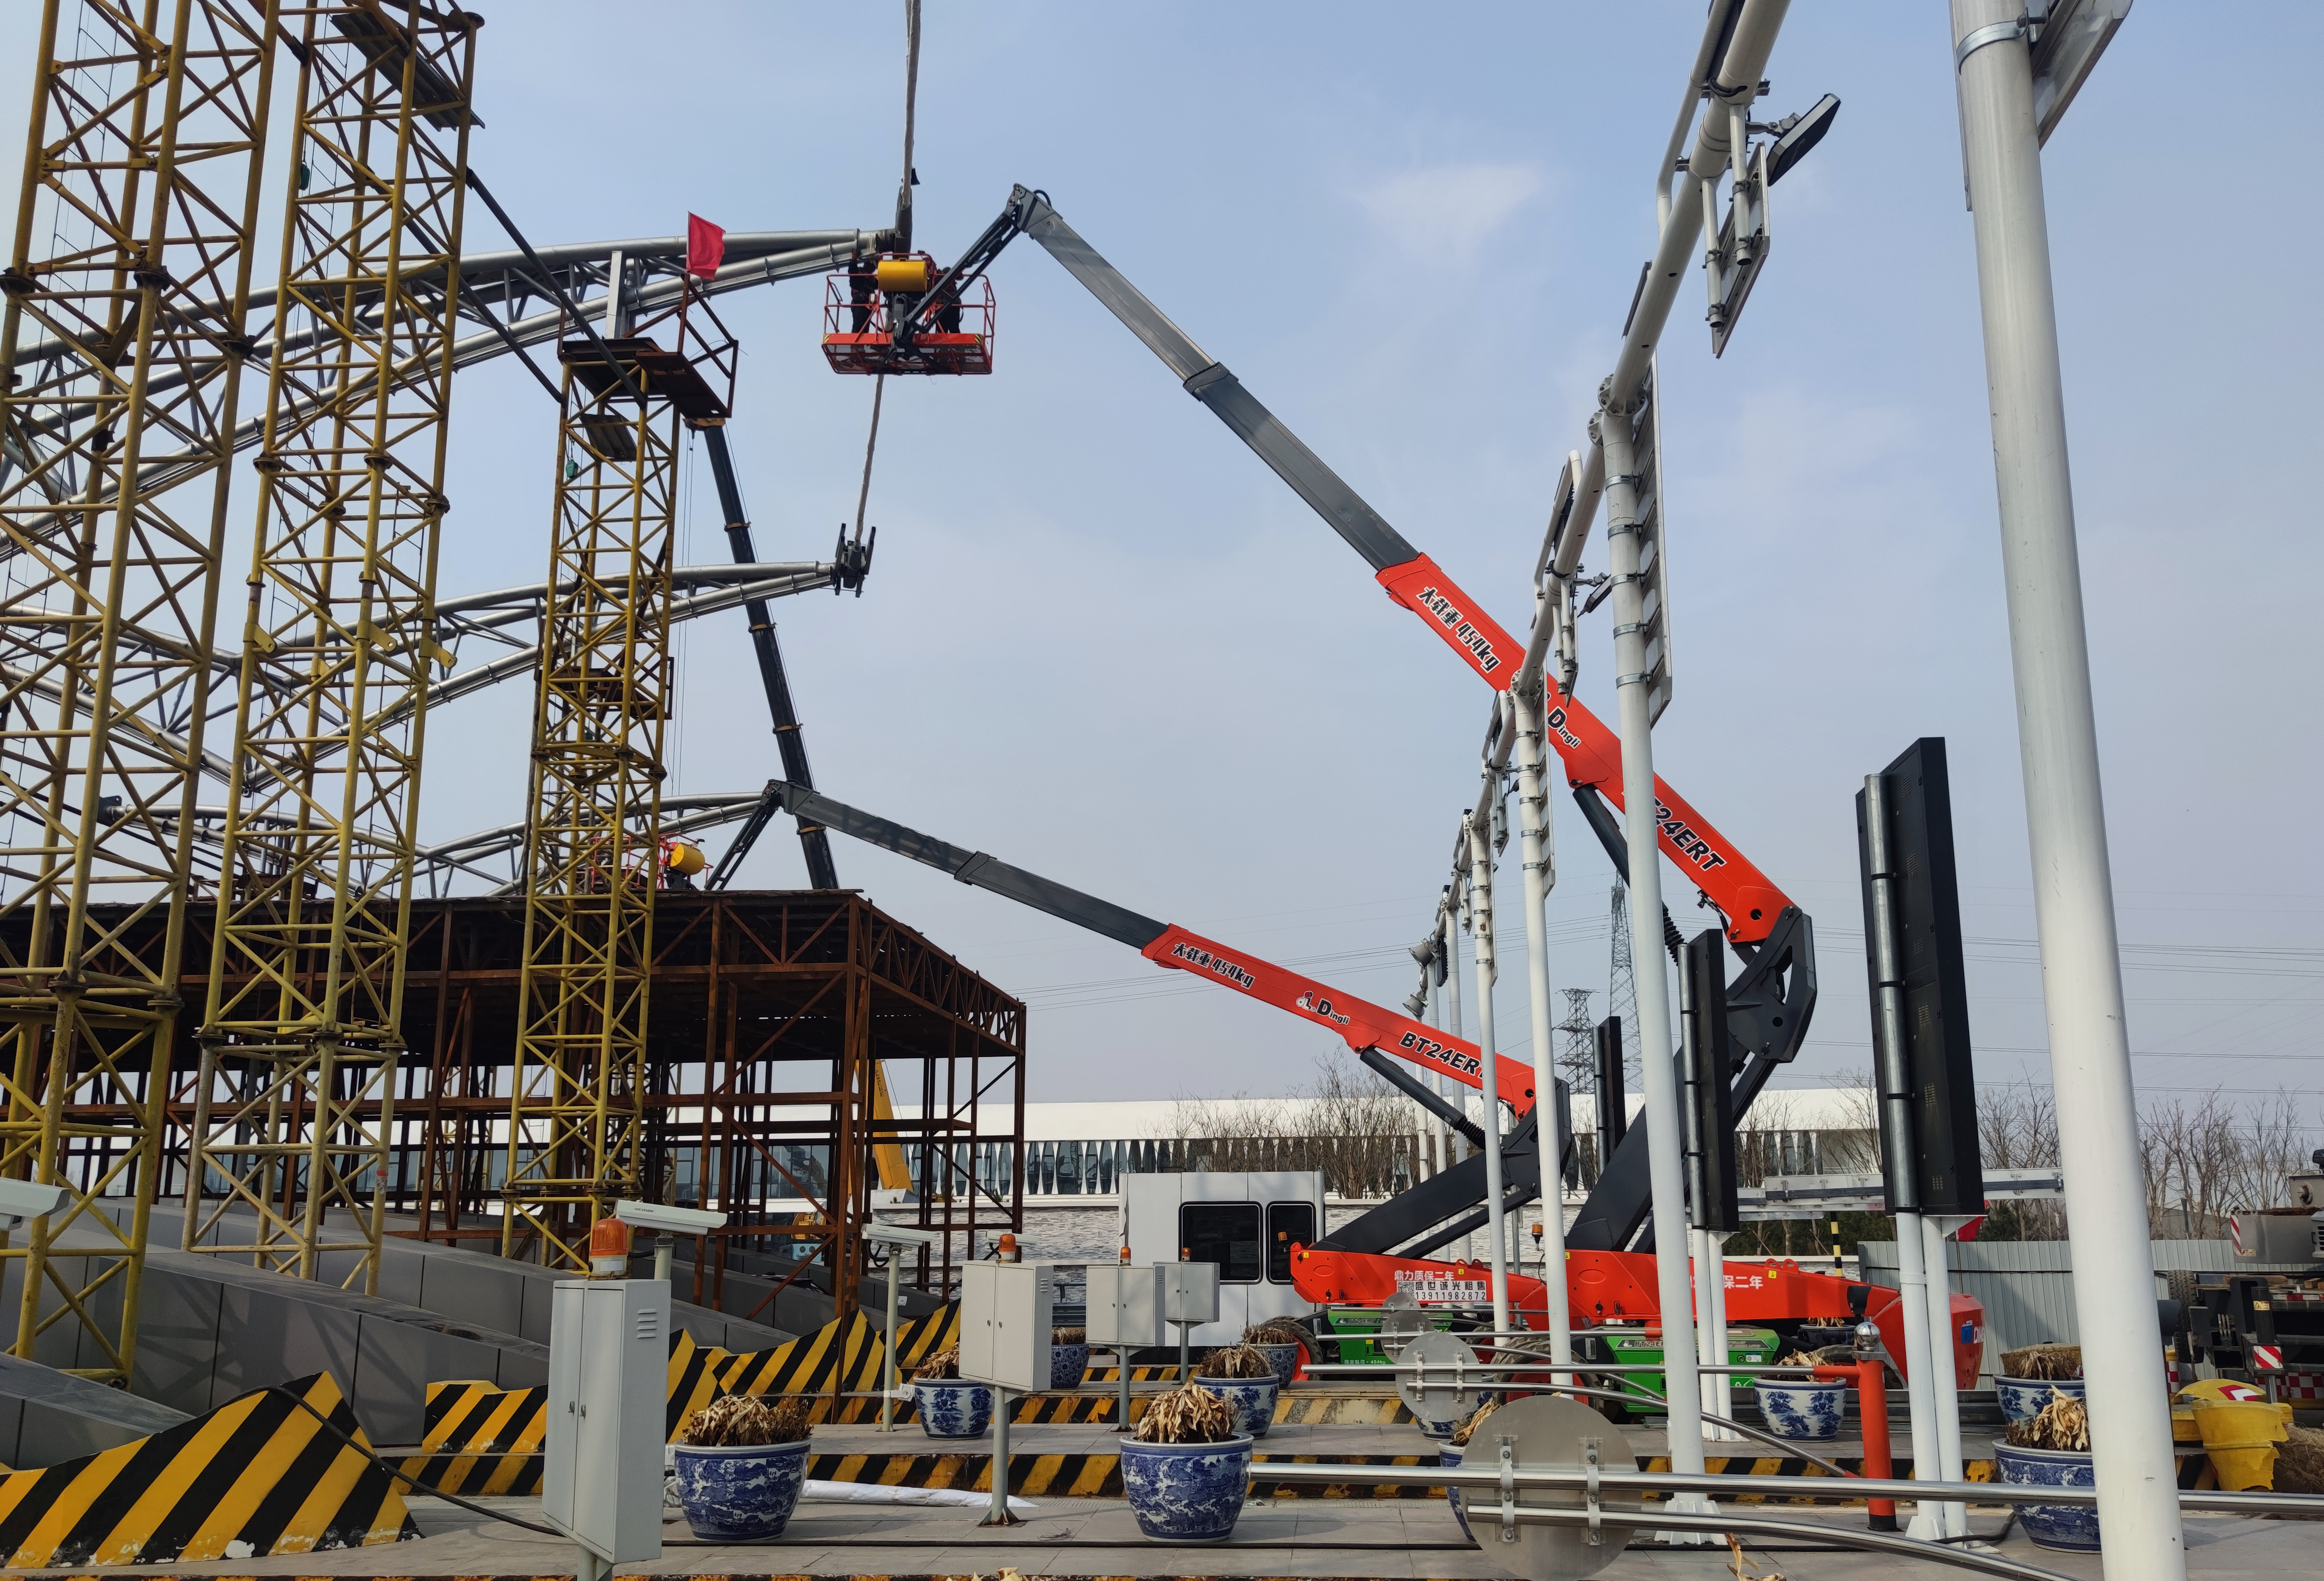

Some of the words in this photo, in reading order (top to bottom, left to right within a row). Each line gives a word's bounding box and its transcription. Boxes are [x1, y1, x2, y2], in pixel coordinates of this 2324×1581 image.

[1416, 586, 1463, 630] 大载重
[1455, 621, 1501, 674] 454kg
[1548, 706, 1581, 749] Dingli
[1655, 796, 1727, 872] 24ERT
[1171, 942, 1214, 968] 大载重
[1211, 957, 1255, 989] 454kg
[1316, 998, 1350, 1025] Dingli
[1399, 1031, 1484, 1079] BT24ER
[1394, 1270, 1455, 1281] 鼎力质保二年
[1415, 1281, 1485, 1290] 盛世诚光租售
[1416, 1291, 1486, 1300] 13911982872
